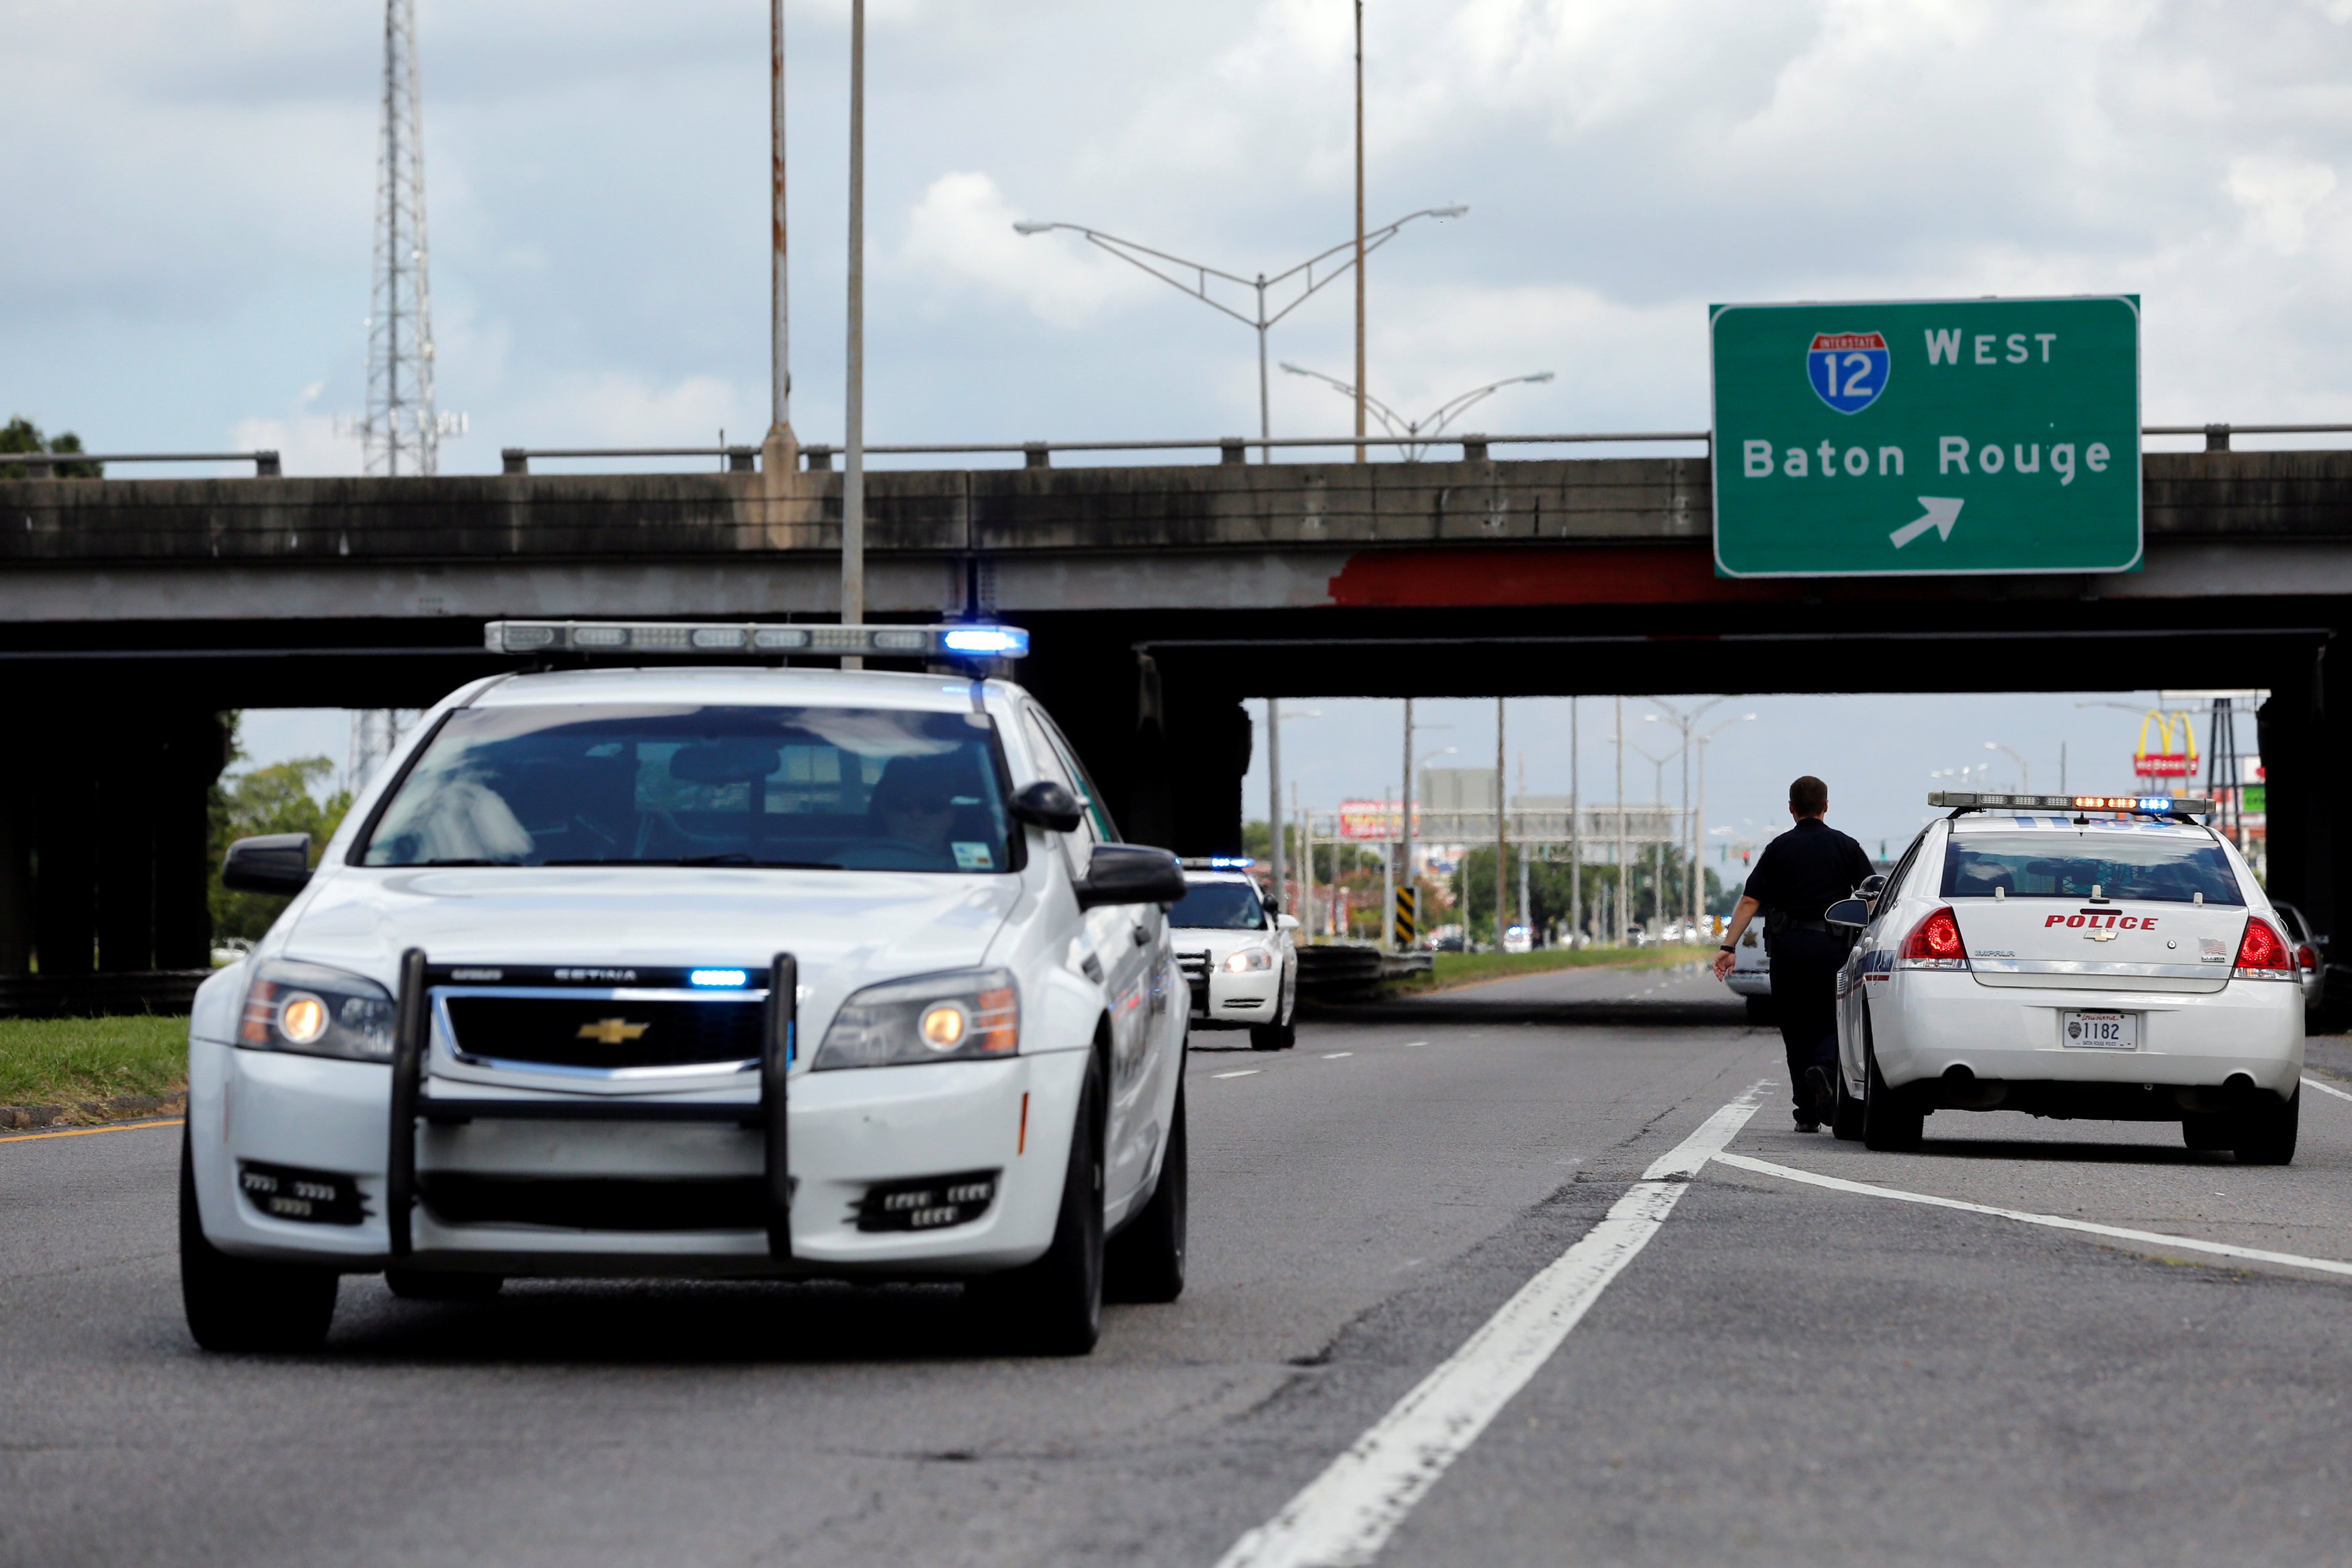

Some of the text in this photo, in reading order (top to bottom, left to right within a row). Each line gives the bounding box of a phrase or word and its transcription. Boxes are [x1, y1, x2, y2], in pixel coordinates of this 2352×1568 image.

[1820, 337, 1875, 349] INTERSTATE
[1925, 329, 2056, 365] WEST
[1824, 352, 1873, 397] 12
[1744, 436, 2111, 486] Baton Rouge
[2044, 915, 2159, 930] POLICE
[2085, 1022, 2119, 1039] 1182
